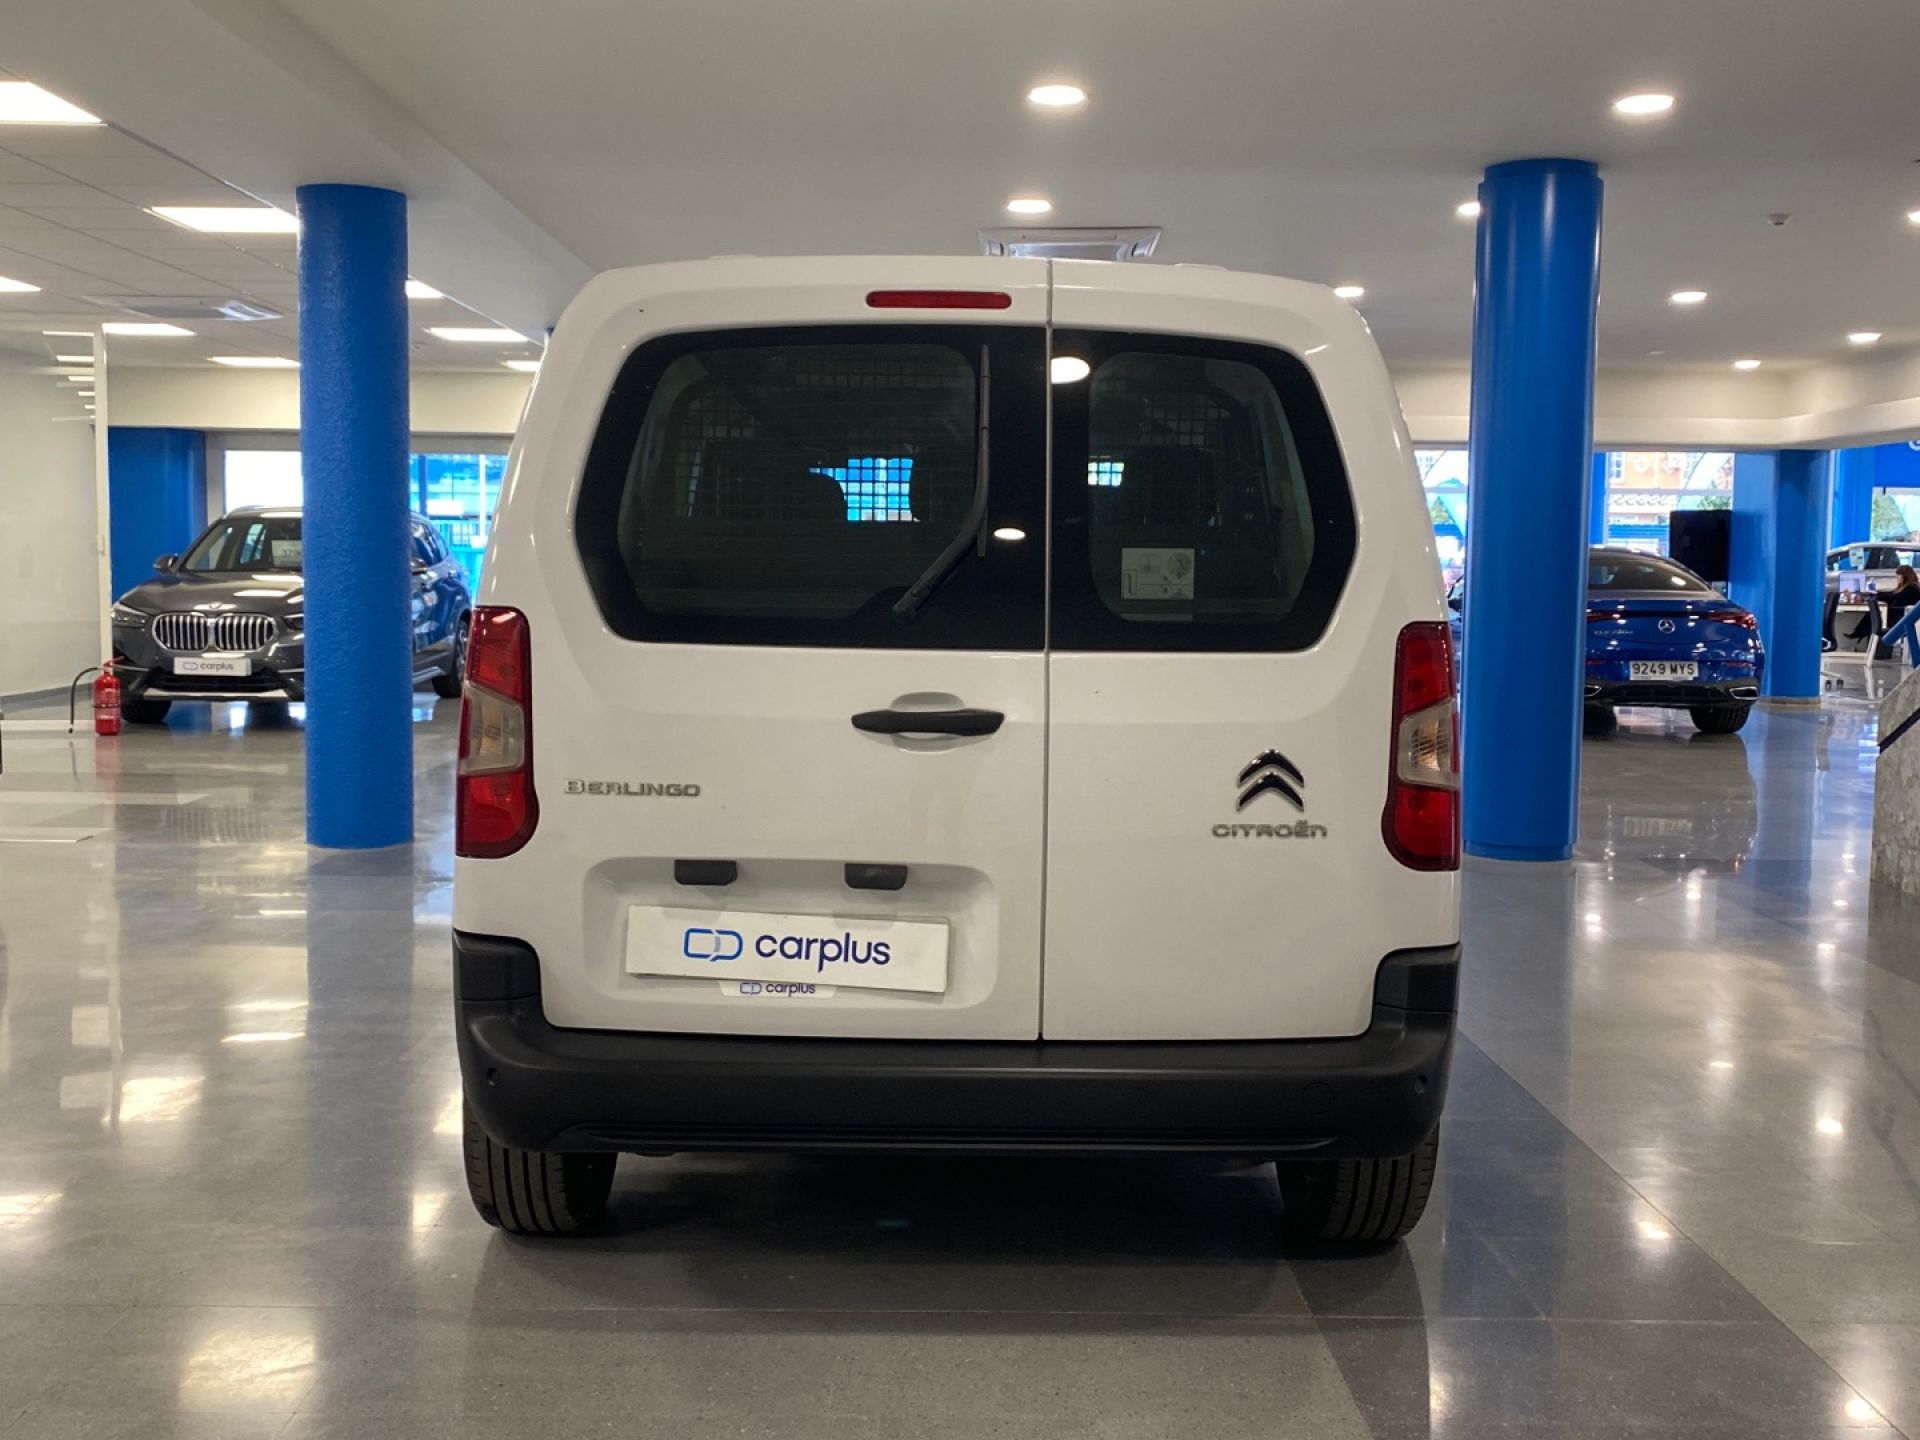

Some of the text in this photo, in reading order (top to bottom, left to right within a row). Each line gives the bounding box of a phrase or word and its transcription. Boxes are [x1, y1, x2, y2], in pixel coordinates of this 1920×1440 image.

[1632, 663, 1695, 675] 9249 MYS
[564, 779, 701, 797] BERLINGO
[755, 932, 891, 973] carplus
[765, 982, 816, 997] carplus
